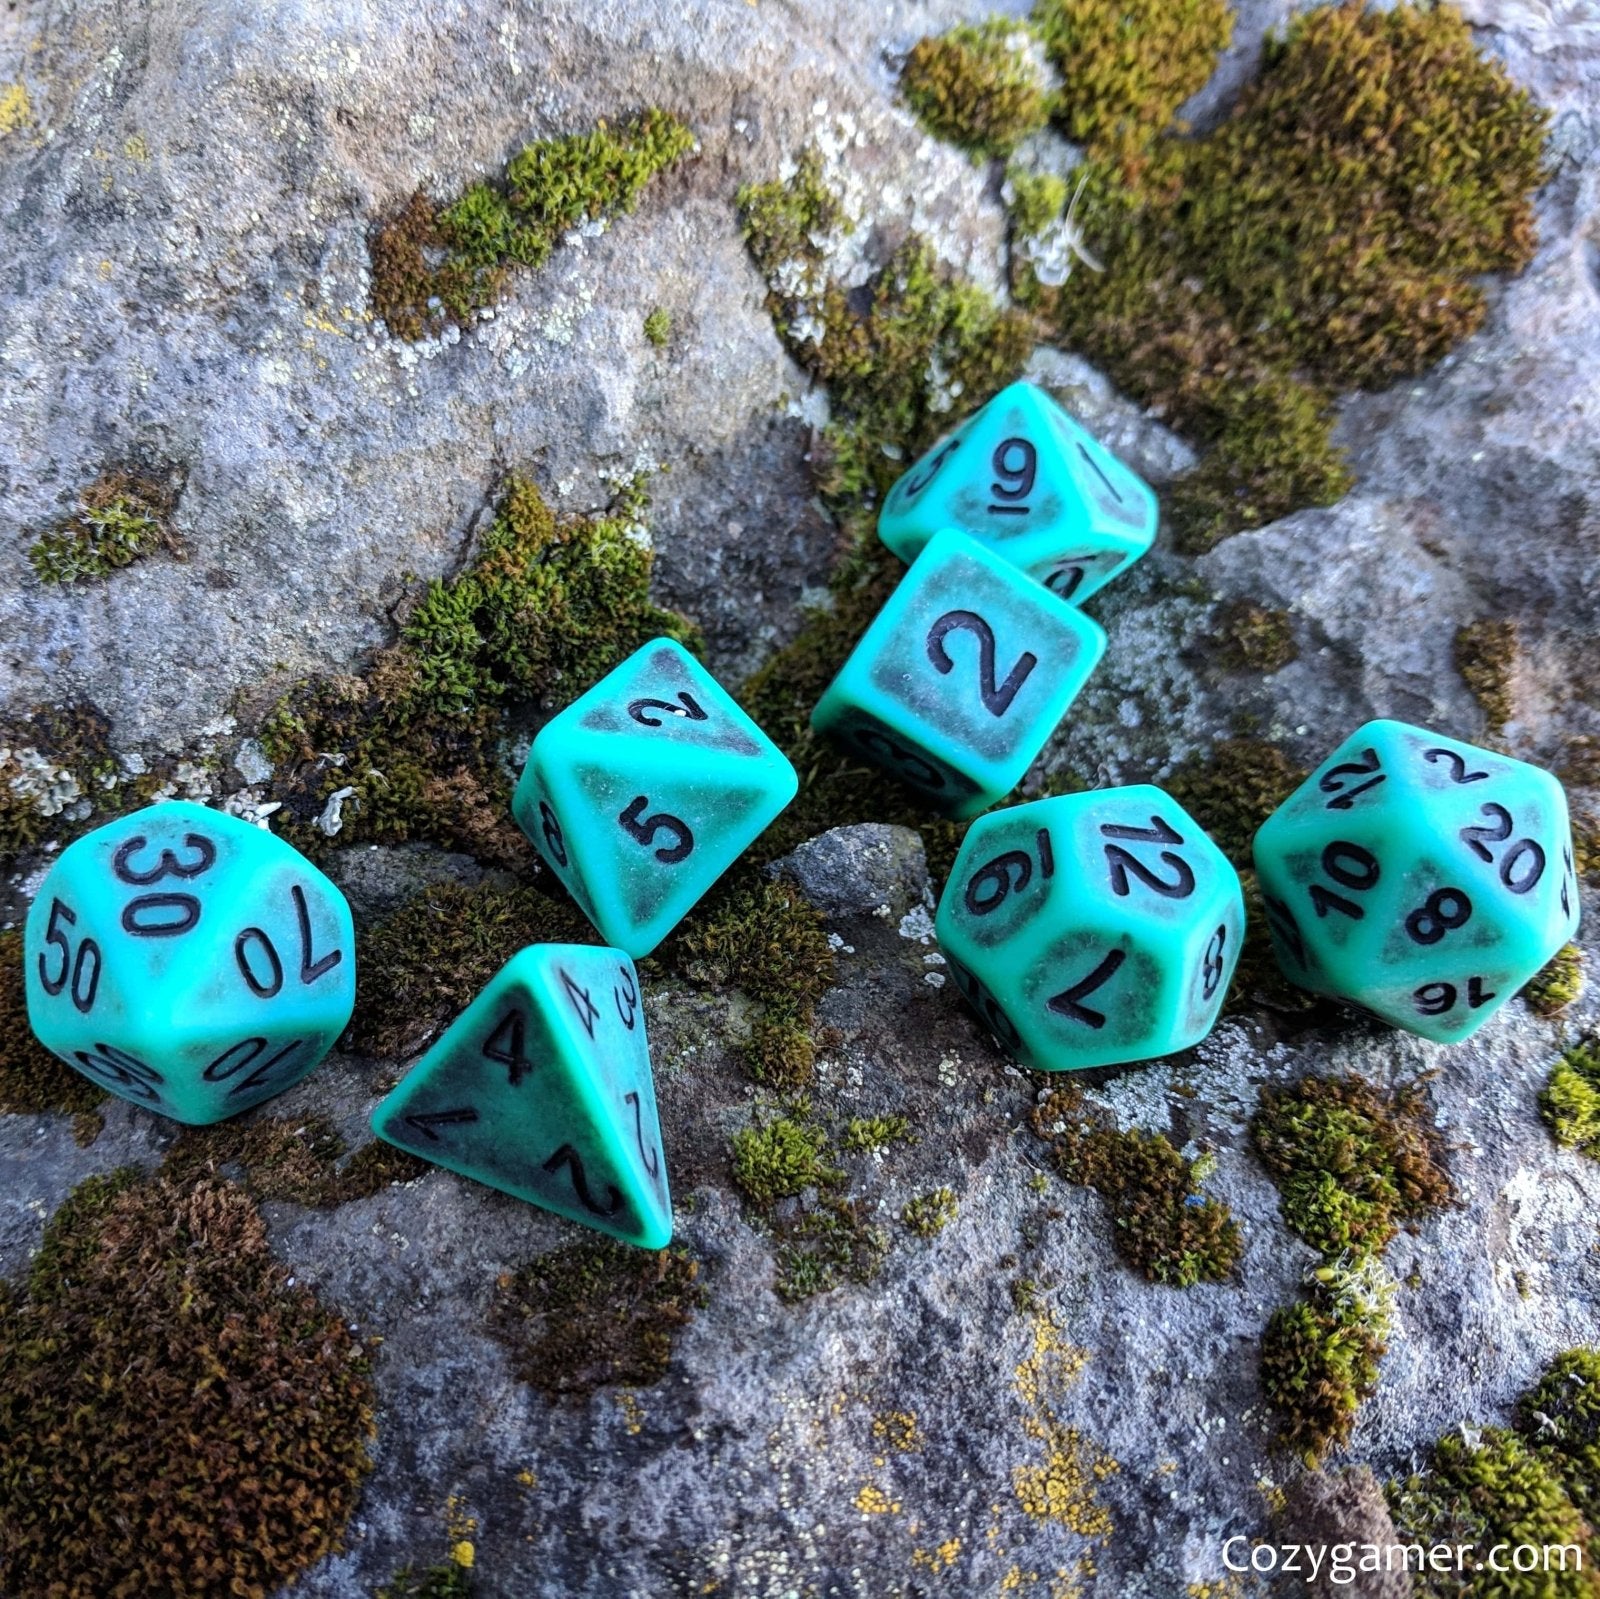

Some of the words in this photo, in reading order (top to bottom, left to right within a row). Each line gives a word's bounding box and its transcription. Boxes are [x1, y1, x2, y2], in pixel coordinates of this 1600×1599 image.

[927, 610, 1037, 717] 2
[628, 692, 708, 727] 2
[1319, 748, 1386, 809] 12
[1423, 748, 1489, 784] 2
[618, 795, 694, 865] 5
[1101, 816, 1195, 899] 12
[1460, 802, 1546, 894] 20
[113, 832, 217, 937] 30
[1309, 840, 1380, 919] 10
[1405, 887, 1472, 944] 8
[39, 896, 101, 1013] 50
[235, 885, 342, 998] 70
[1203, 924, 1226, 1001] 8
[560, 967, 600, 1040] 4
[614, 966, 638, 1030] 3
[1046, 949, 1126, 1029] 7
[482, 1009, 532, 1087] 4
[405, 1106, 479, 1141] 1
[625, 1091, 659, 1179] 2
[543, 1143, 622, 1216] 2
